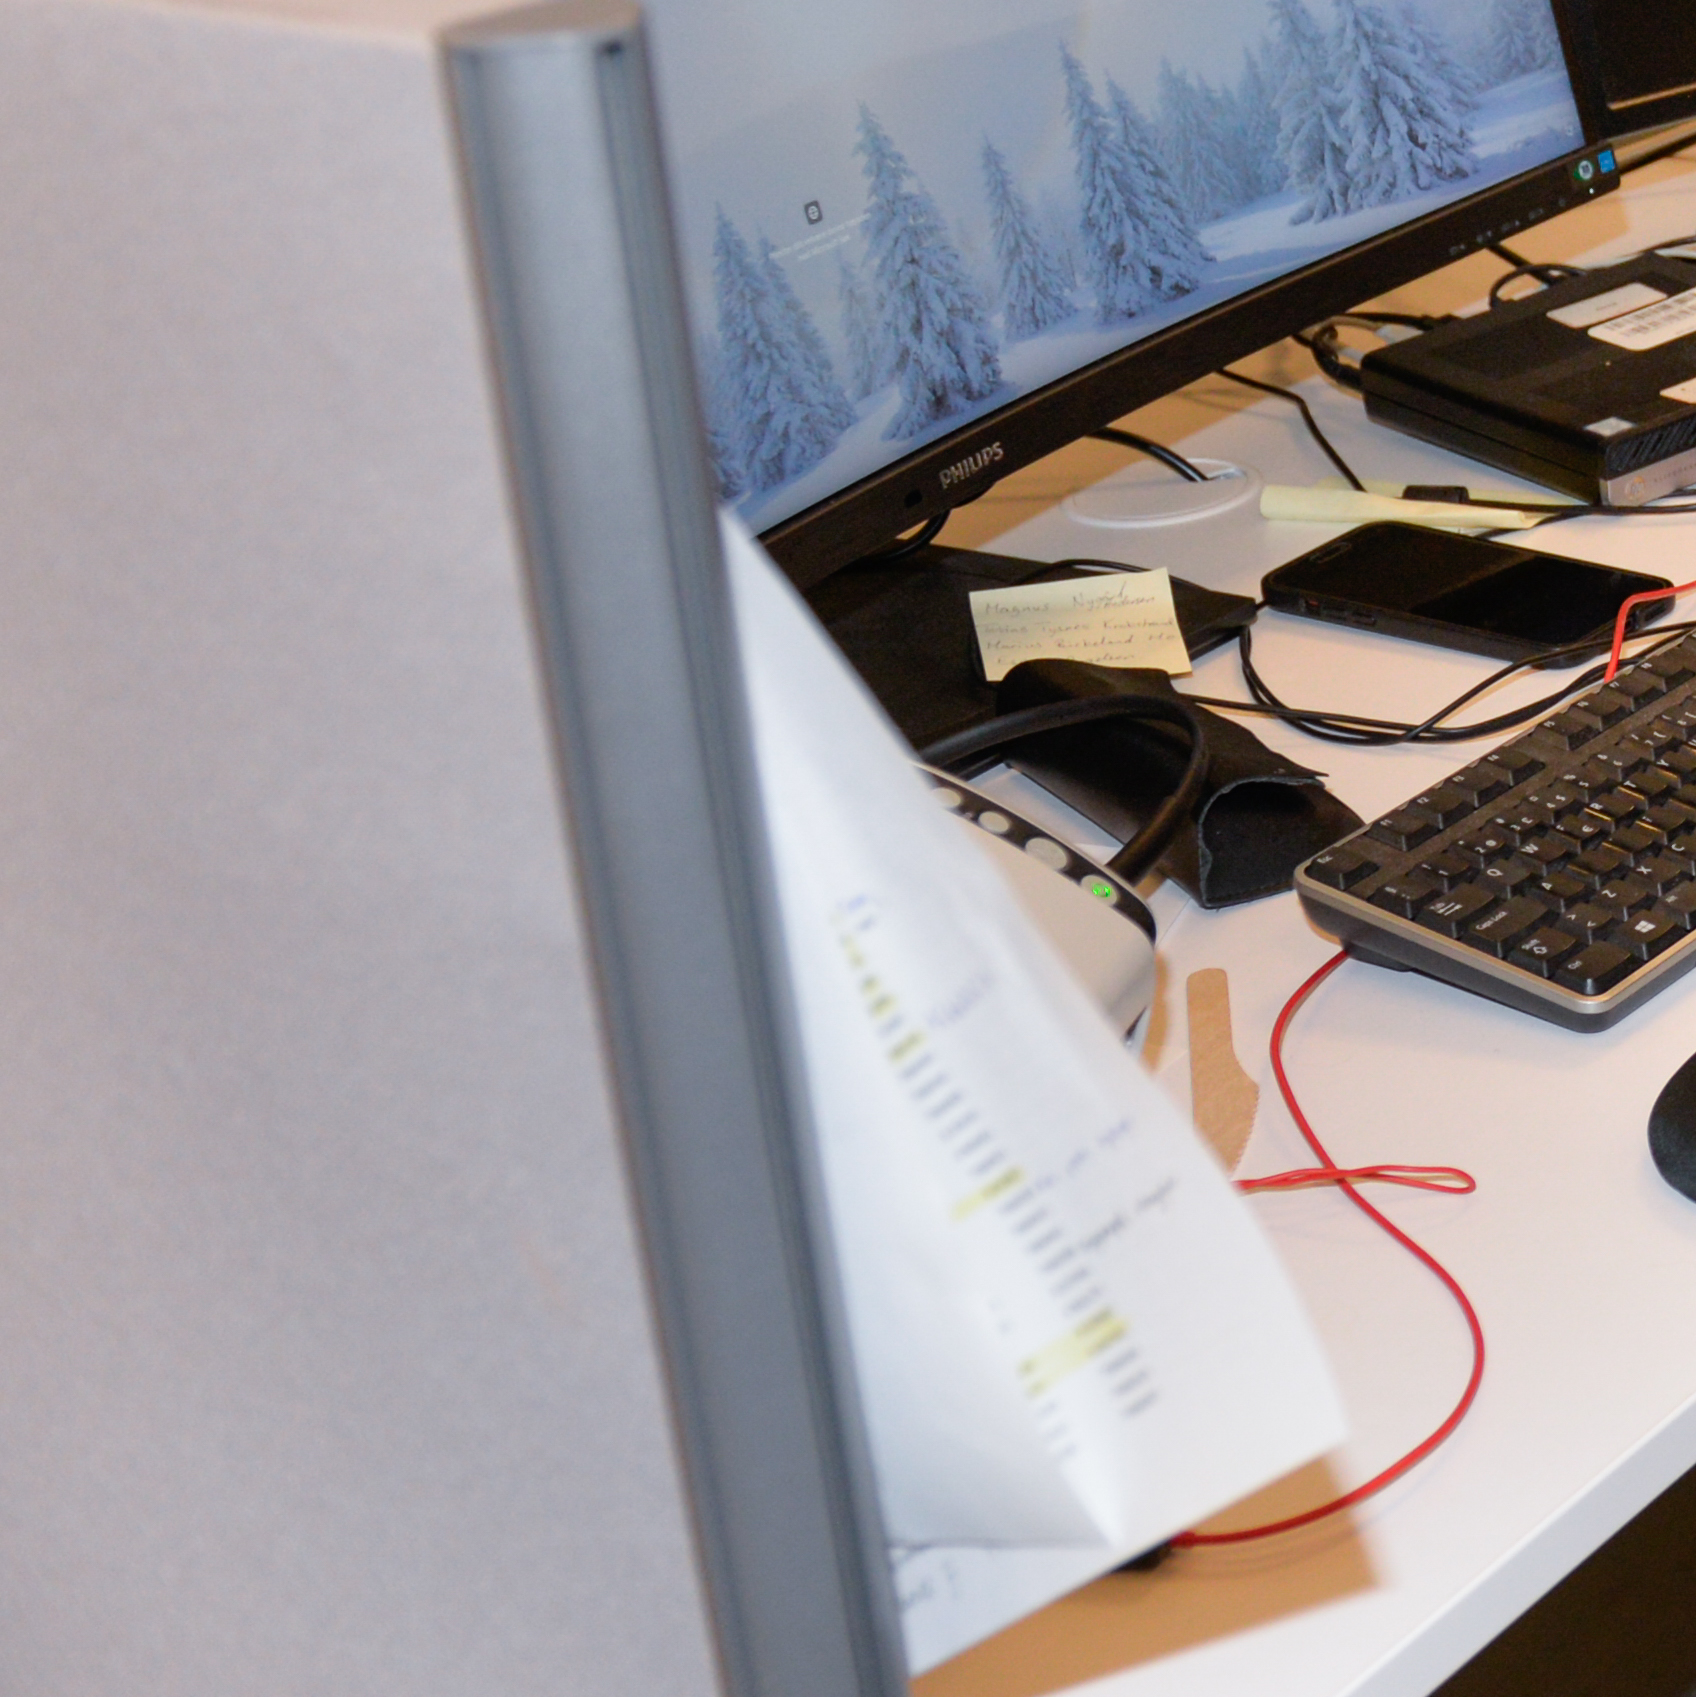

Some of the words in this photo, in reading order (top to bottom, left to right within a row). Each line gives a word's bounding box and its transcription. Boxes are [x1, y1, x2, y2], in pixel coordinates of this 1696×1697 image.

[939, 441, 1005, 490] PHILIPS
[984, 602, 1049, 617] Magnus
[1656, 758, 1670, 768] Y
[1416, 796, 1430, 805] F2
[1380, 818, 1393, 827] F1
[1520, 843, 1539, 854] W
[1486, 868, 1504, 877] Q
[1636, 865, 1652, 875] X
[1541, 881, 1552, 891] A
[1475, 918, 1492, 931] Caps
[1492, 911, 1508, 923] Lock
[1521, 938, 1541, 950] Shift
